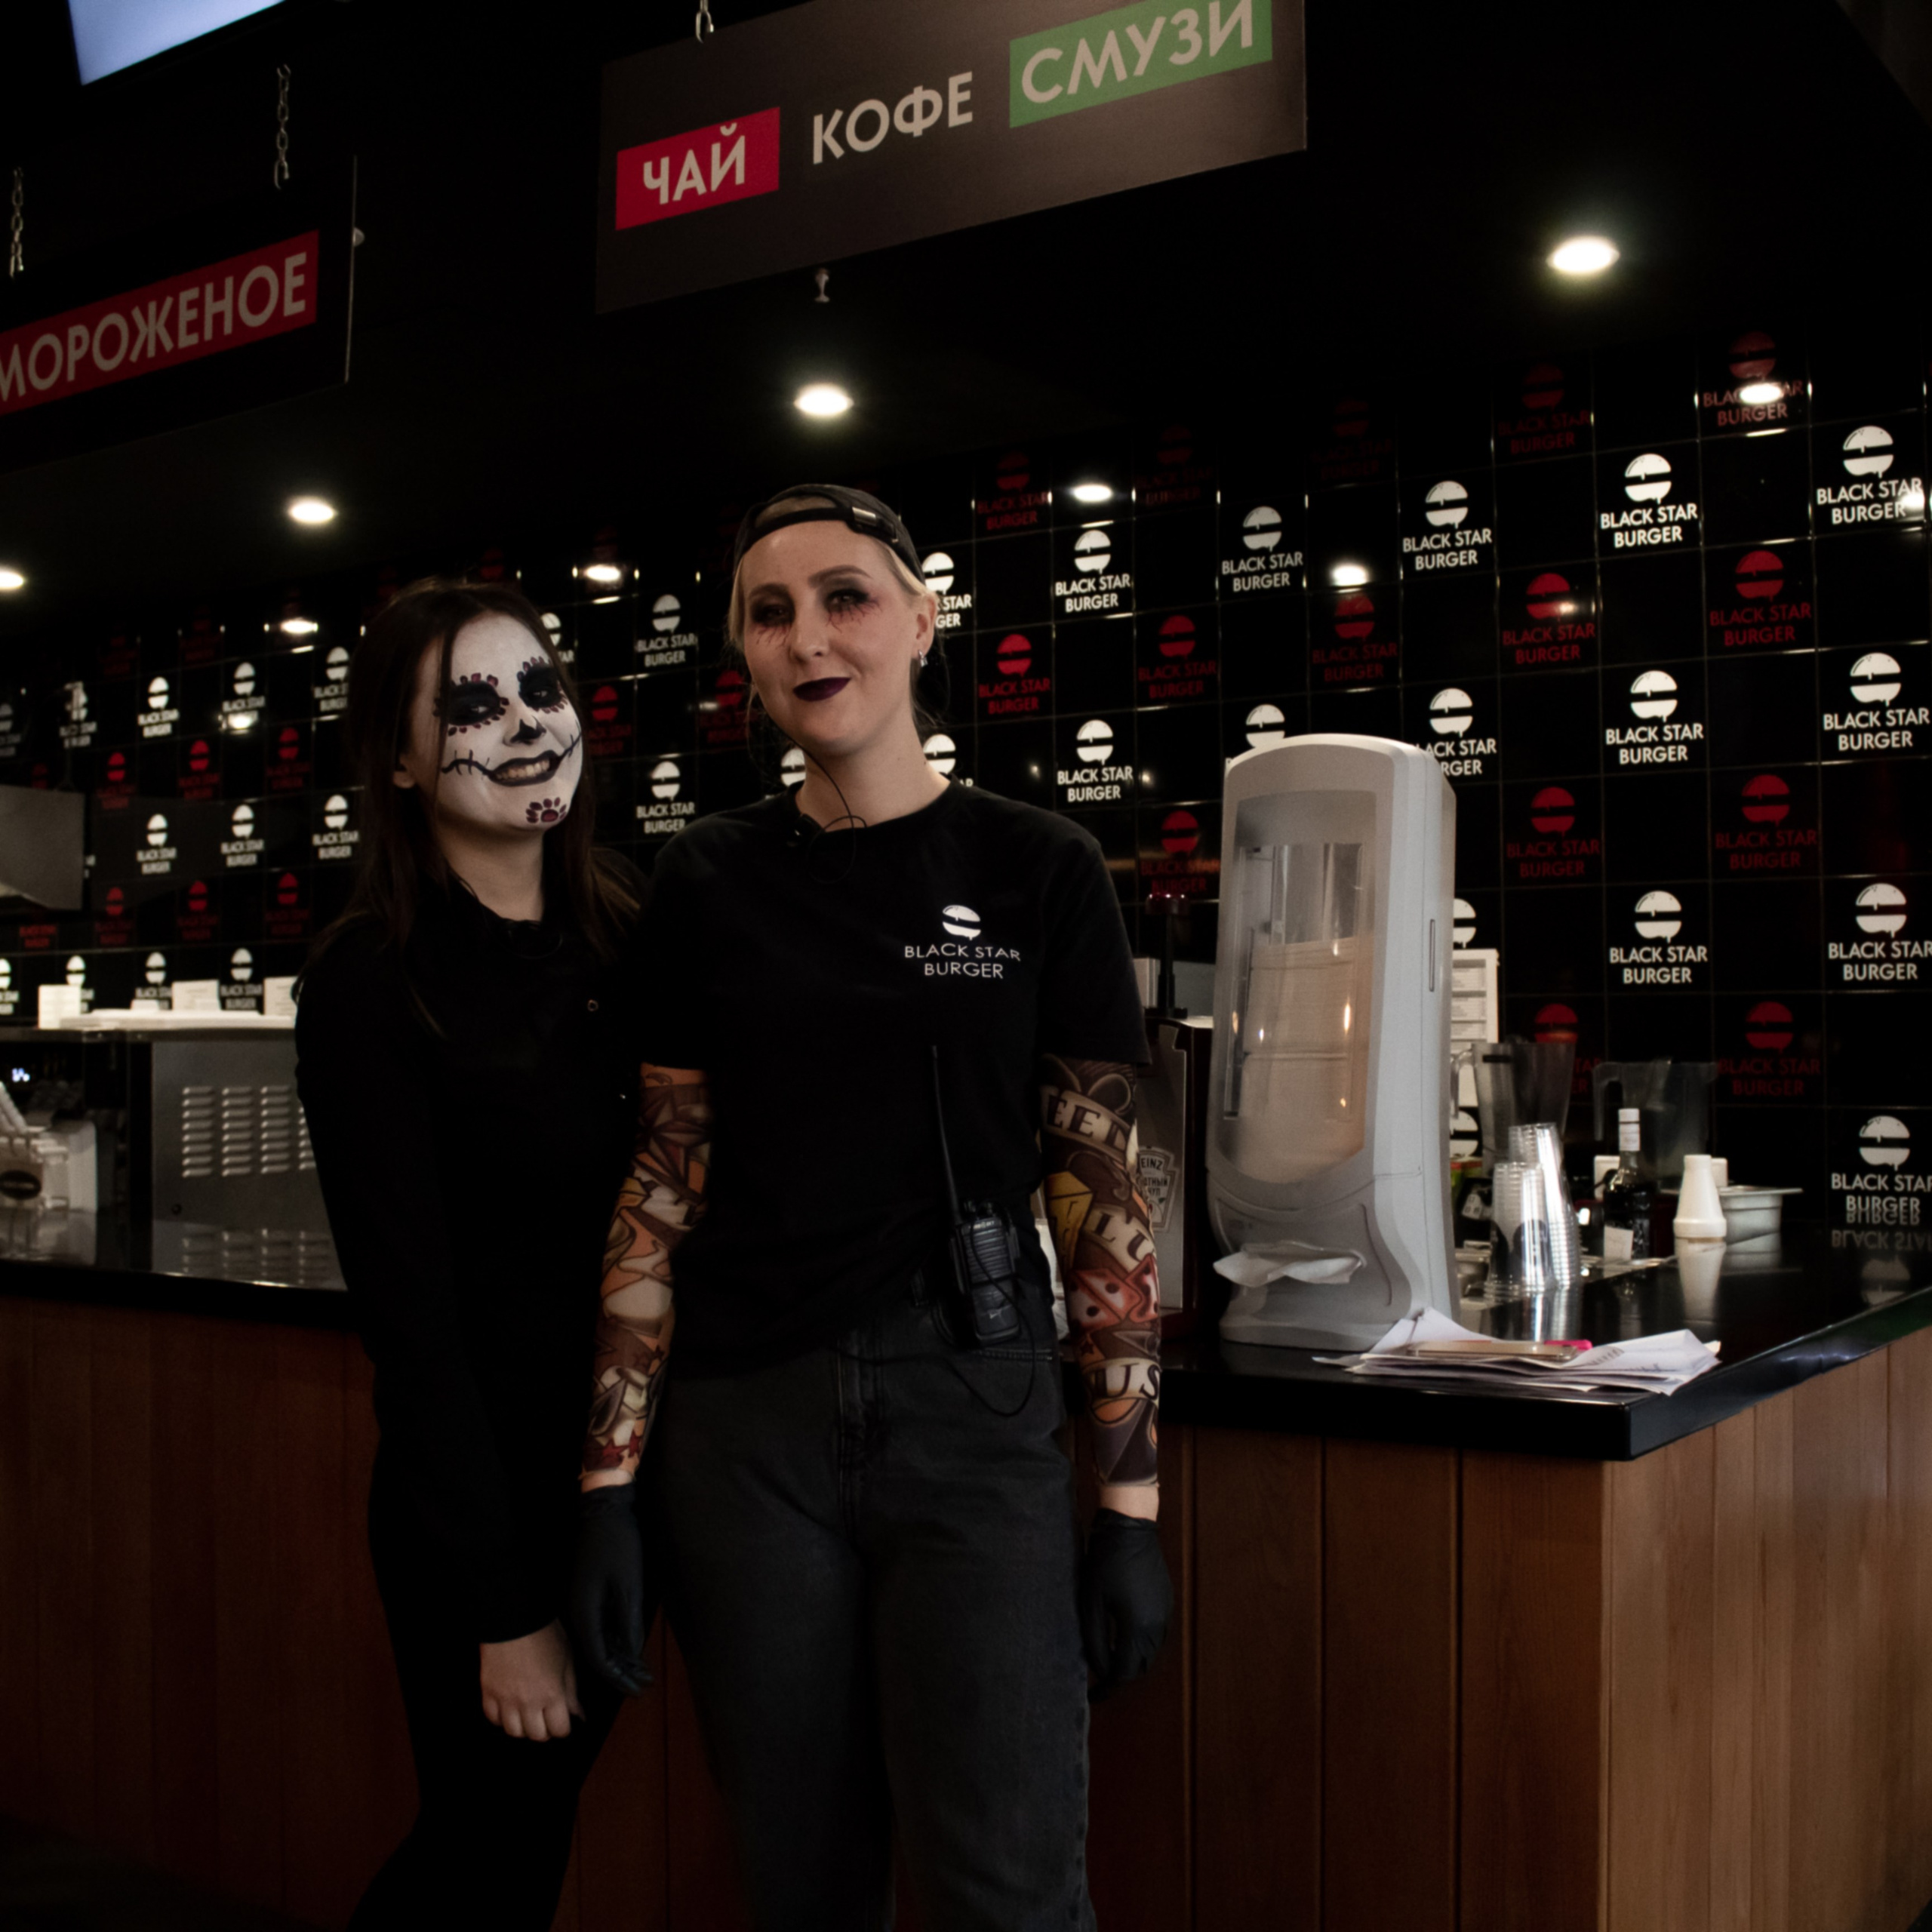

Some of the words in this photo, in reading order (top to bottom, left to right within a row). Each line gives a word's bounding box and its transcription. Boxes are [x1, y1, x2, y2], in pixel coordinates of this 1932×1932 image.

[642, 122, 746, 205] ЧАЙ
[813, 71, 973, 165] КОФЕ
[1022, 0, 1254, 104] СМУЗИ
[1717, 402, 1788, 428] BURGER
[1817, 481, 1875, 506] BLACK
[1879, 477, 1922, 502] STAR
[1600, 507, 1654, 531] BLACK
[1657, 502, 1699, 524] STAR
[1832, 501, 1906, 525] BURGER
[1402, 531, 1451, 554] BLACK
[1454, 528, 1493, 549] STAR
[1614, 525, 1683, 549] BURGER
[1221, 555, 1263, 576] BLACK
[1265, 551, 1303, 571] STAR
[1414, 549, 1478, 571] BURGER
[1055, 577, 1098, 597] BLACK
[1100, 573, 1131, 592] STAR
[1232, 572, 1291, 592] BURGER
[1065, 592, 1119, 614] BURGER
[1709, 607, 1765, 628] BLACK
[1768, 601, 1811, 622] STAR
[637, 638, 669, 654] BLACK
[670, 632, 695, 649] STAR
[1503, 626, 1553, 646] BLACK
[1556, 623, 1596, 641] STAR
[1724, 624, 1795, 648] BURGER
[644, 649, 687, 669] BURGER
[1312, 645, 1354, 666] BLACK
[1357, 641, 1398, 661] STAR
[1515, 644, 1581, 666] BURGER
[1137, 663, 1177, 682] BLACK
[1180, 660, 1217, 678] STAR
[1323, 662, 1386, 682] BURGER
[978, 681, 1018, 700] BLACK
[1021, 677, 1051, 696] STAR
[1148, 680, 1205, 700] BURGER
[987, 695, 1040, 716] BURGER
[1823, 710, 1881, 731] BLACK
[1886, 706, 1930, 728] STAR
[1605, 725, 1660, 746] BLACK
[1663, 721, 1705, 742] STAR
[1838, 729, 1913, 752] BURGER
[1416, 740, 1457, 758] ACK
[1459, 737, 1497, 756] STAR
[1618, 743, 1688, 765] BURGER
[1057, 768, 1100, 787] BLACK
[1101, 765, 1133, 785] STAR
[1440, 758, 1483, 777] RGER
[1066, 784, 1121, 804] BURGER
[1506, 841, 1557, 860] BLACK
[1561, 838, 1601, 857] STAR
[1714, 831, 1767, 851] BLACK
[1772, 829, 1818, 848] STAR
[1519, 857, 1585, 878] BURGER
[1729, 850, 1801, 871] BURGER
[904, 942, 968, 960] BLACK
[974, 945, 1022, 962] STAR
[1609, 946, 1663, 965] BLACK
[1666, 943, 1709, 964] STAR
[1827, 941, 1887, 960] BLACK
[924, 961, 1004, 980] BURGER
[1622, 964, 1693, 985] BURGER
[1842, 962, 1919, 982] BURGER
[1719, 1057, 1770, 1077] BLACK
[1774, 1057, 1821, 1076] STAR
[1732, 1076, 1805, 1098] BURGER
[1140, 1157, 1163, 1171] EINZ
[1830, 1172, 1889, 1192] BLACK
[1845, 1193, 1921, 1212] BURGER
